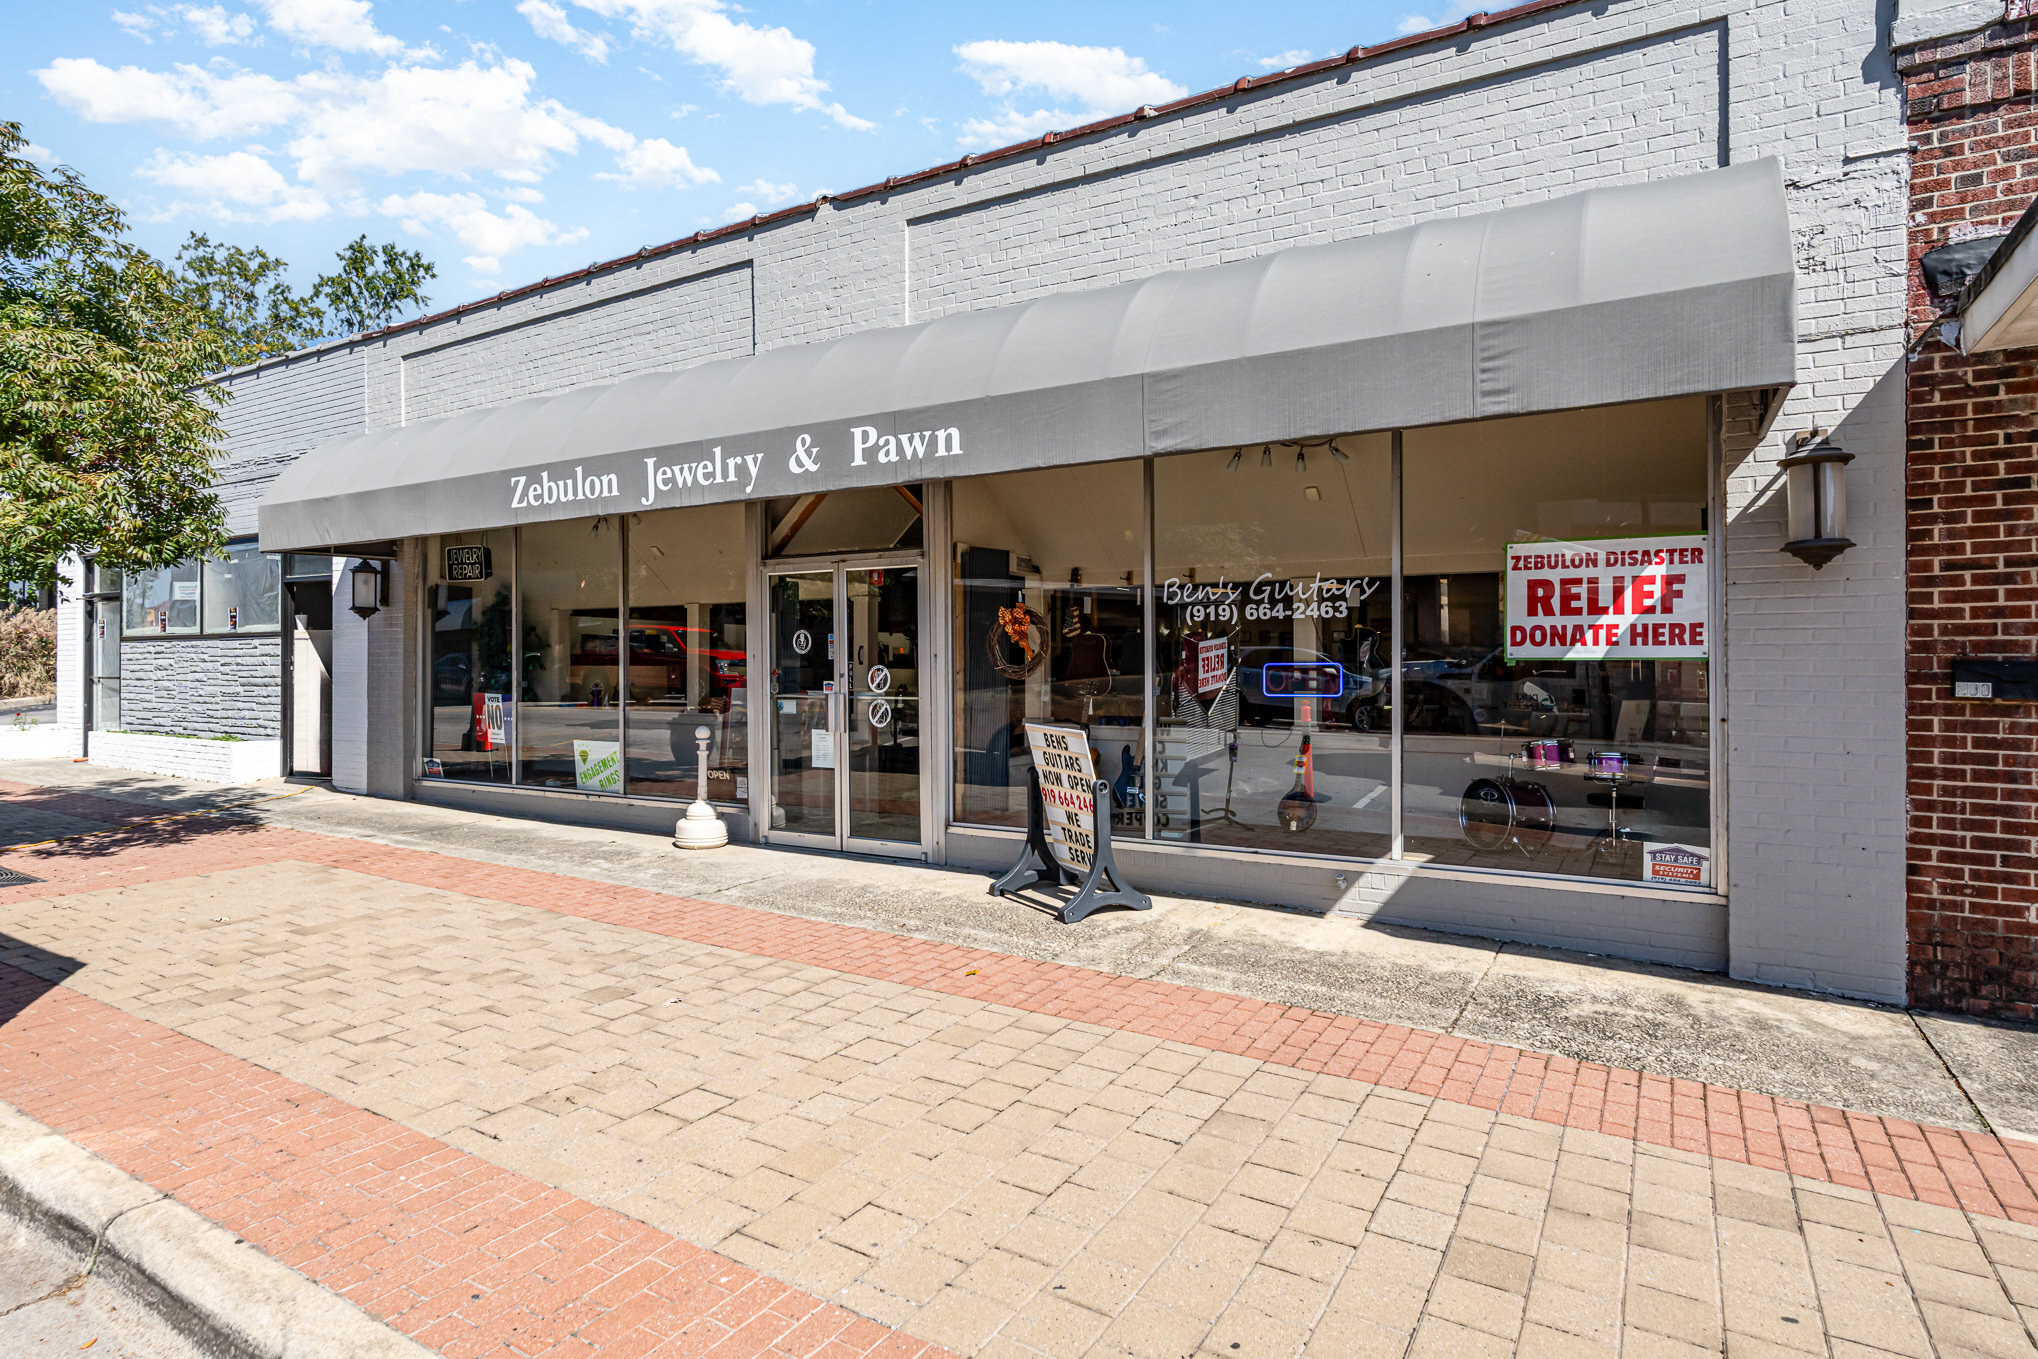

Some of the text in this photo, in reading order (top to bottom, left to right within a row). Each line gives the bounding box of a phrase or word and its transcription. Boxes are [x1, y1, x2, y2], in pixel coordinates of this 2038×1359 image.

[510, 425, 963, 508] Zebulon Jewelry & Pawn
[449, 548, 482, 564] JEWELRY
[1510, 547, 1704, 571] ZEBULON DISASTER
[452, 564, 481, 579] REPAIR
[1162, 571, 1380, 605] Ben's Guitars
[1526, 573, 1686, 617] RELIEF
[1185, 601, 1348, 625] (919) 664-2463
[1509, 622, 1705, 647] DONATE HERE
[1267, 668, 1339, 692] OPEN
[486, 704, 503, 731] NO
[1043, 732, 1068, 751] BENS
[579, 750, 620, 785] ENGAGEMENT
[1042, 750, 1082, 773] GUITARS
[598, 769, 620, 792] RINGS
[707, 769, 730, 780] OPEN
[1041, 768, 1093, 794] NOW OPEN
[1041, 786, 1055, 804] 919
[1058, 790, 1075, 808] 664
[1065, 809, 1081, 828] WE
[1061, 826, 1093, 850] TRADE
[1654, 865, 1699, 875] SECURITY
[1655, 853, 1676, 862] STAY
[1677, 855, 1698, 865] SAFE
